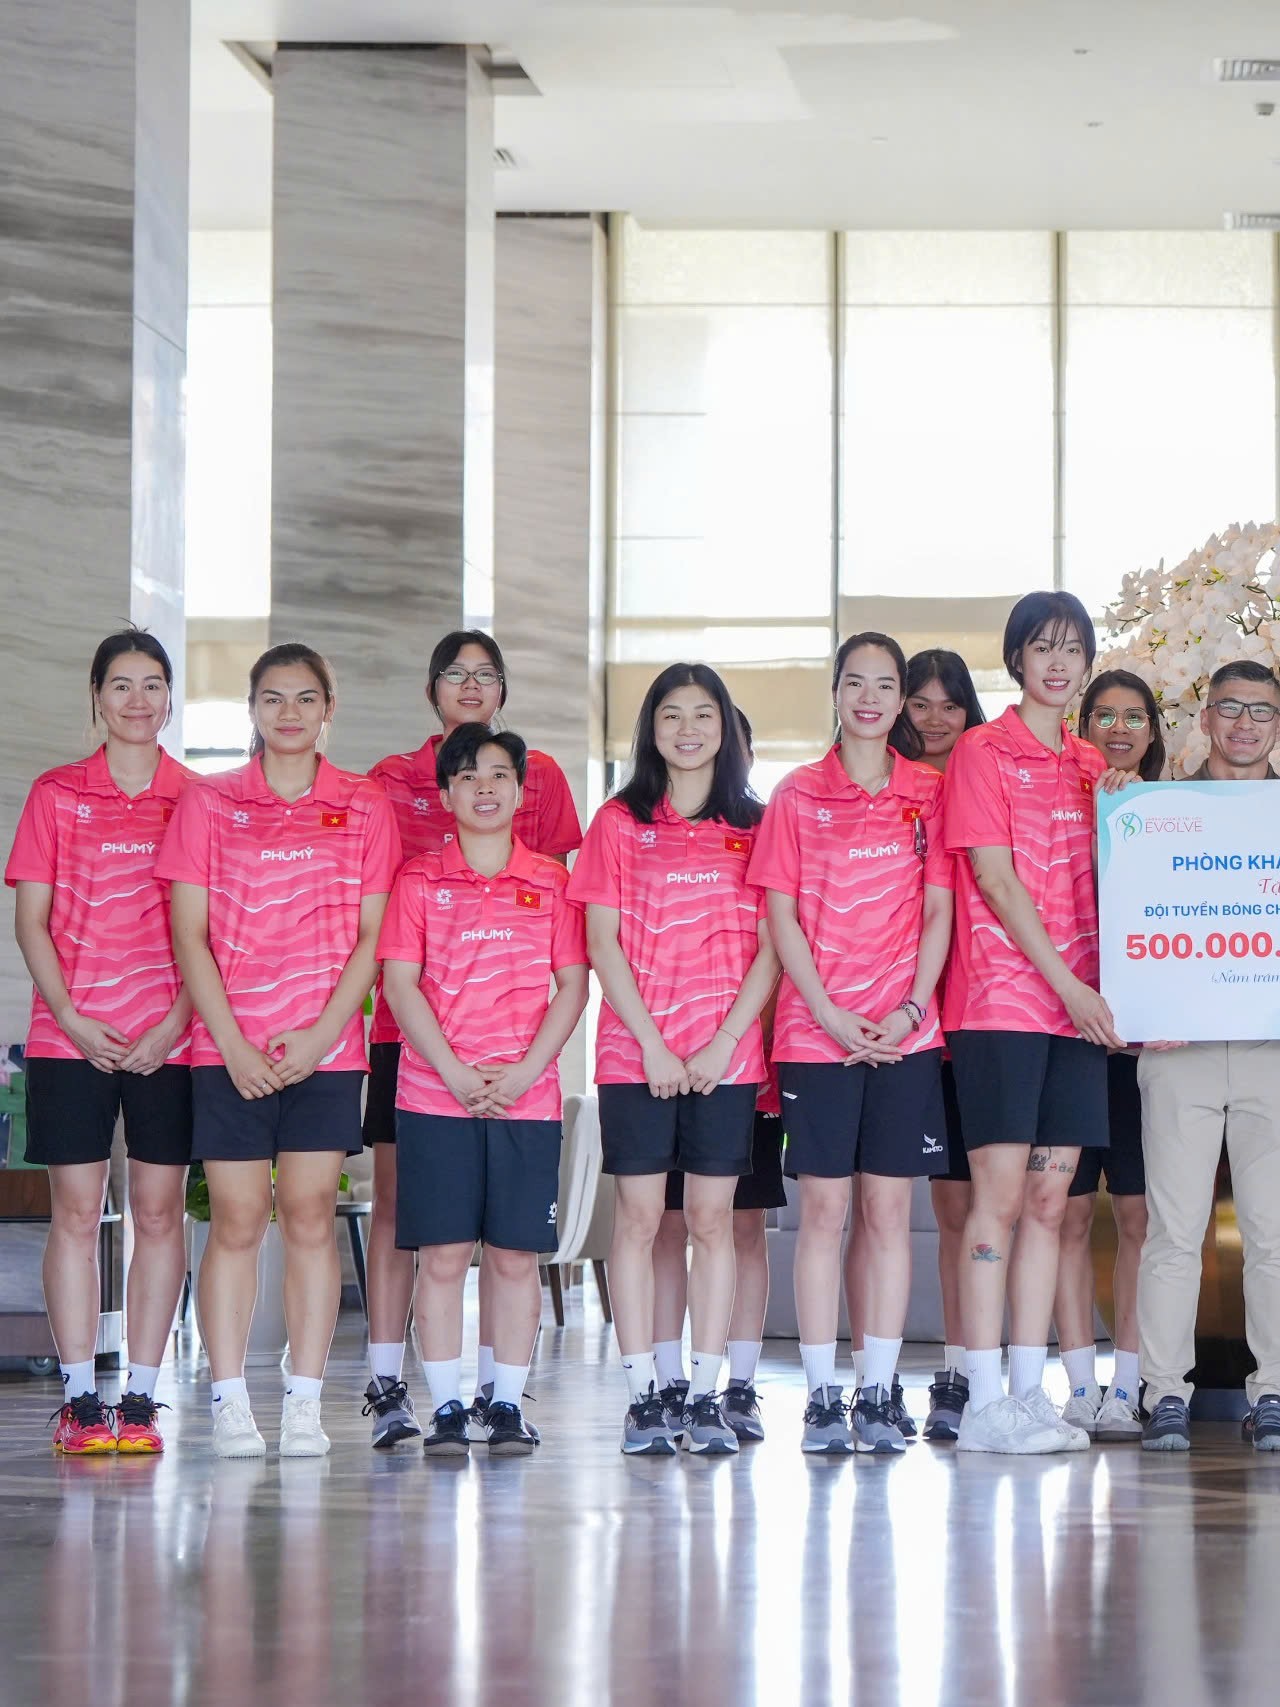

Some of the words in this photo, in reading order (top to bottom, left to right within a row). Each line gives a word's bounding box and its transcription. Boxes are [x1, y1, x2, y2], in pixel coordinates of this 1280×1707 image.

[1145, 821, 1203, 832] EVOLVE
[1172, 852, 1243, 871] PHÒNG
[1144, 903, 1169, 919] ĐỘI
[1172, 901, 1219, 917] TUYỂN
[1222, 902, 1262, 915] BÓNG
